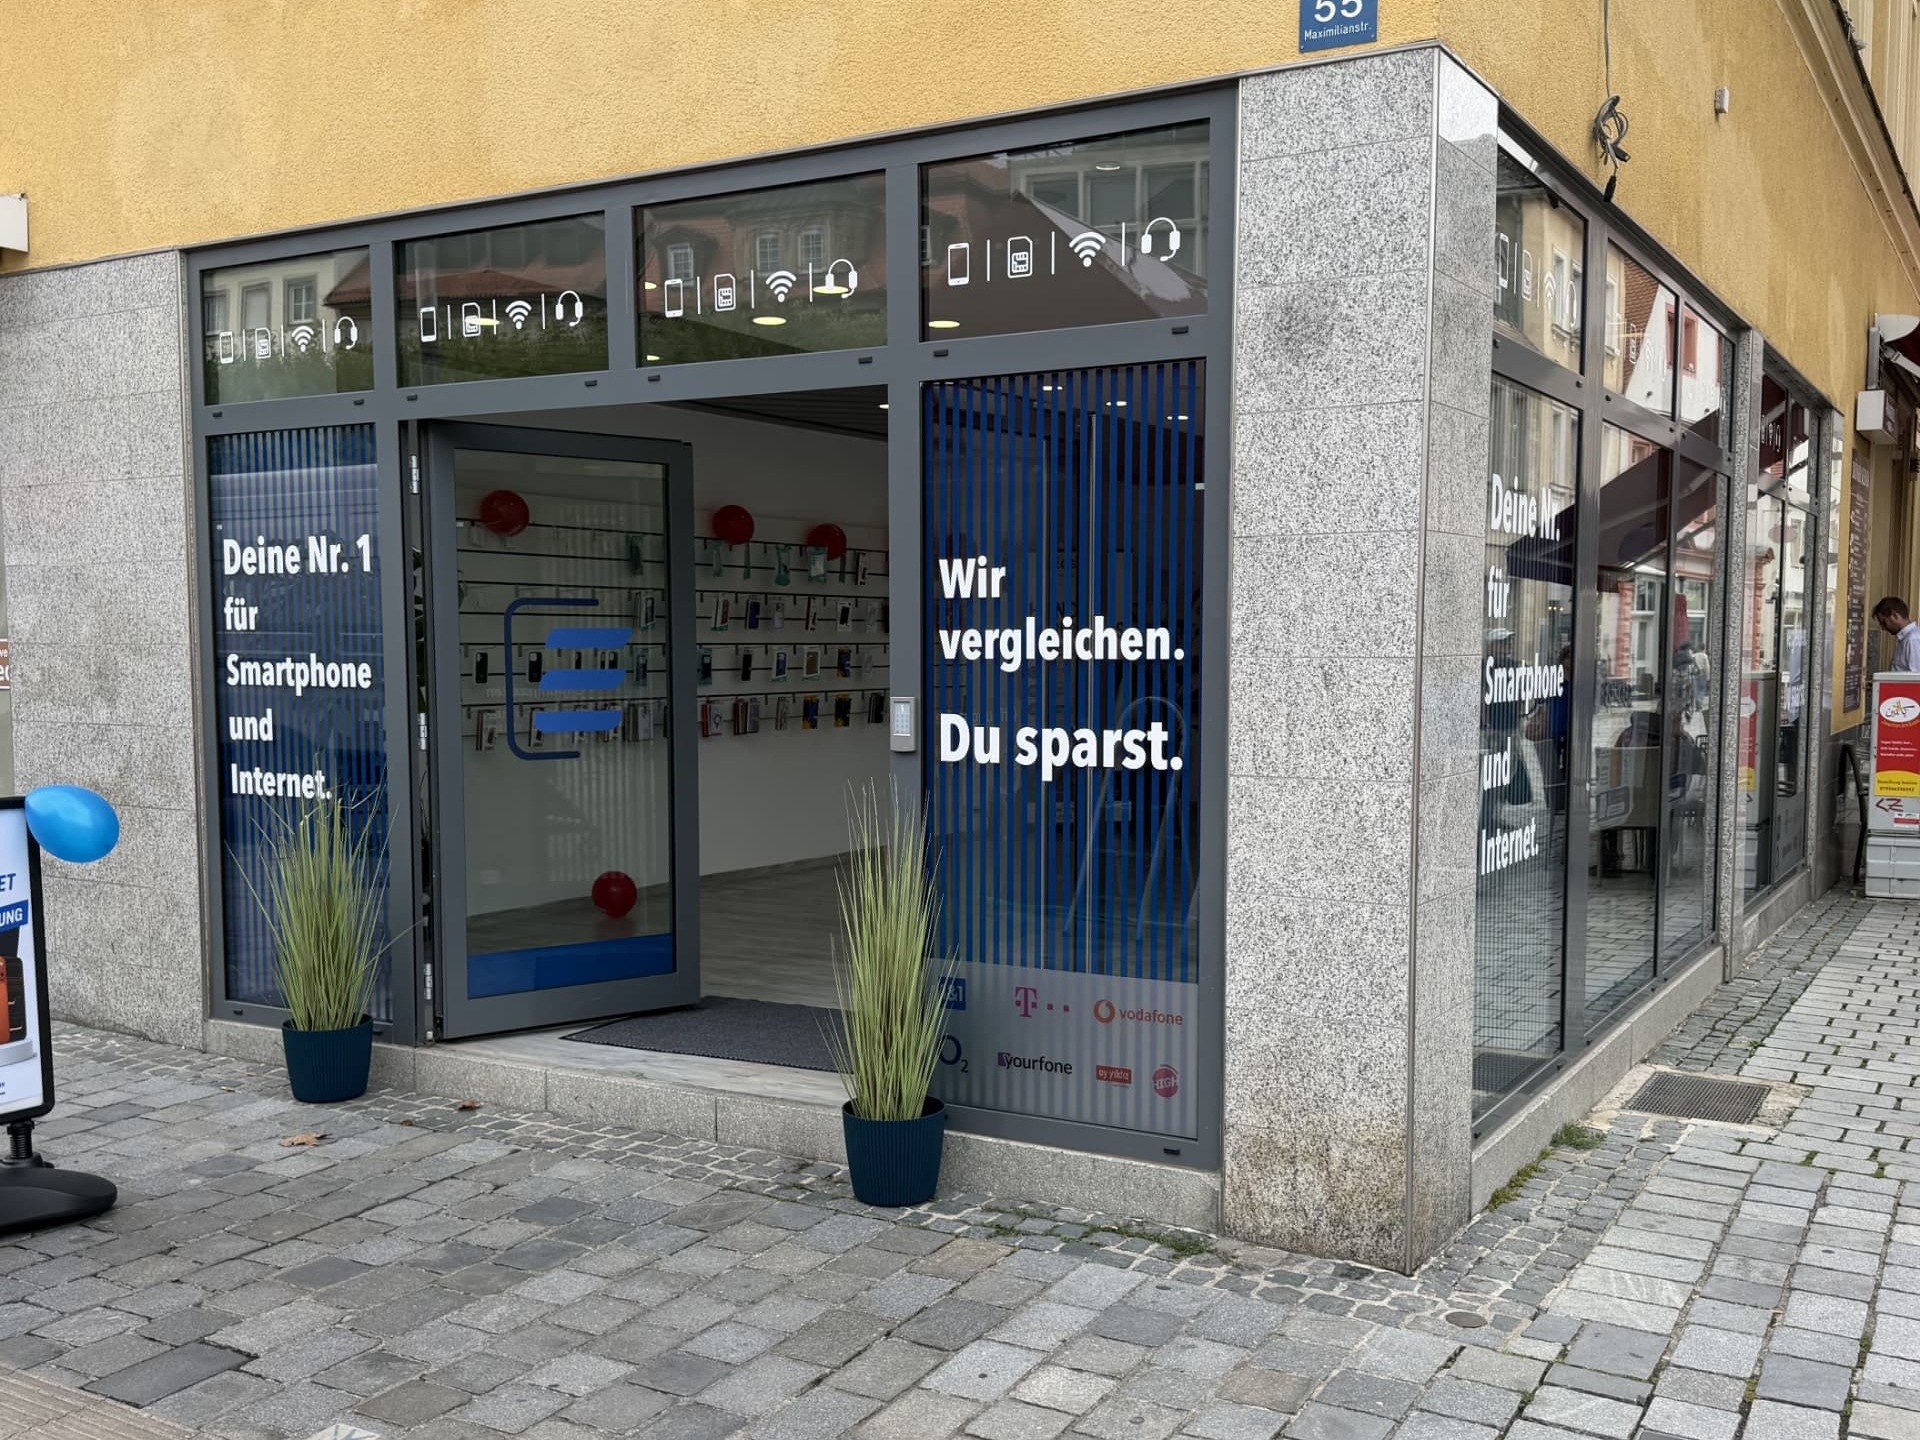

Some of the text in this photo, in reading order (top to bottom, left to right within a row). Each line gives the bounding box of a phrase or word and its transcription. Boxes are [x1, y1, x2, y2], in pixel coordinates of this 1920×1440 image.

[1304, 21, 1372, 40] Maximilianstr.
[1314, 0, 1363, 22] 55
[1491, 473, 1537, 538] Deine
[223, 533, 371, 576] Deine Nr. 1
[938, 555, 1006, 599] Wir
[1487, 564, 1510, 619] für
[223, 596, 258, 631] für
[938, 615, 1185, 673] vergleichen.
[226, 652, 372, 697] Smartphone
[1484, 652, 1564, 715] Smartphone
[229, 708, 274, 741] und
[940, 713, 1183, 782] Du sparst.
[1482, 737, 1511, 790] und
[231, 763, 332, 800] Internet.
[1481, 817, 1539, 875] Internet.
[1119, 1007, 1183, 1026] vodafone
[1003, 1052, 1073, 1075] yourfone
